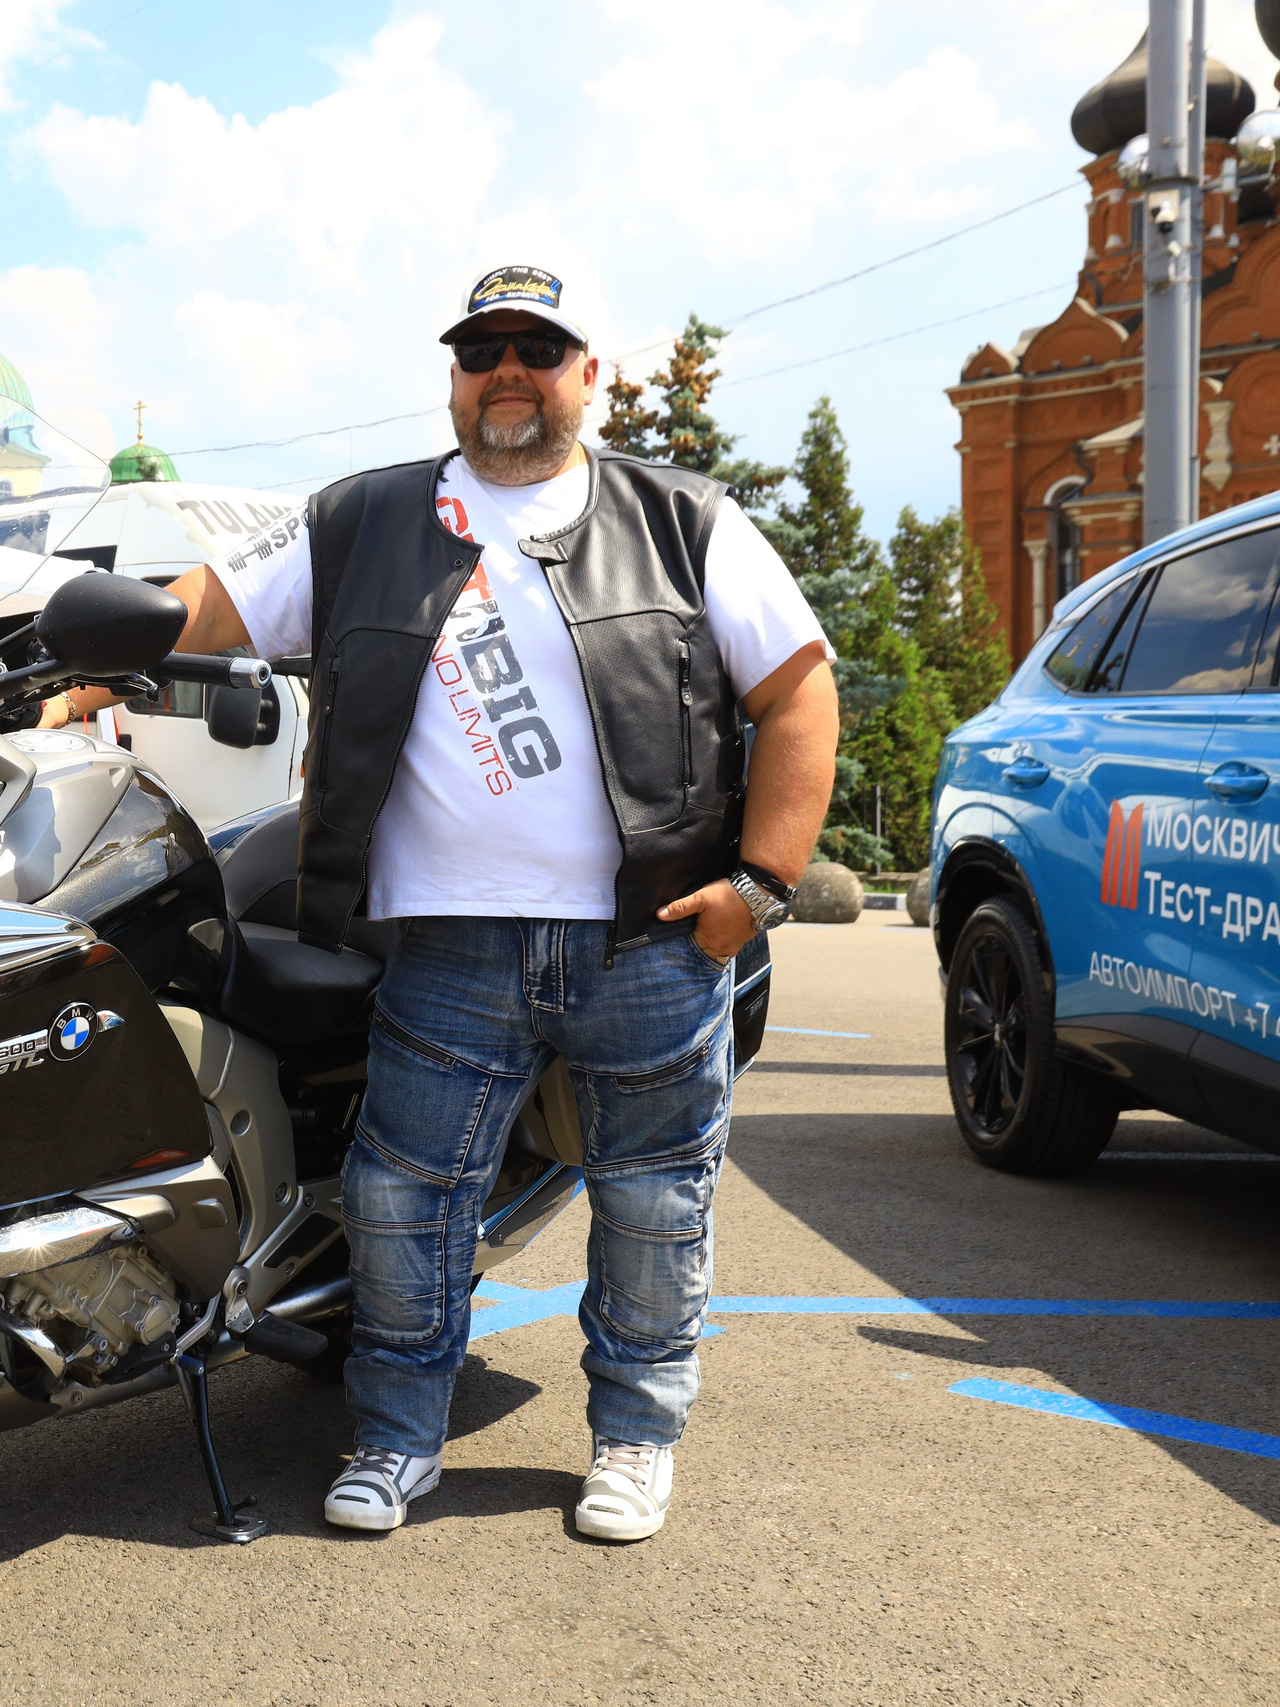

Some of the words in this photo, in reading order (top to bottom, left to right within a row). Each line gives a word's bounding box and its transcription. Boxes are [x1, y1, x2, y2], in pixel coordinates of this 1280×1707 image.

[483, 268, 508, 285] SIMPLY
[512, 266, 529, 274] THE
[532, 269, 553, 282] BEST
[485, 293, 500, 302] FOR
[506, 291, 540, 300] EXPERTS
[448, 692, 513, 797] LIMITS
[1144, 871, 1280, 945] ТЕСТ-ДРА
[56, 1007, 96, 1031] BMW
[1089, 951, 1237, 1027] АВТОИМПОРТ
[1244, 1001, 1270, 1039] +7
